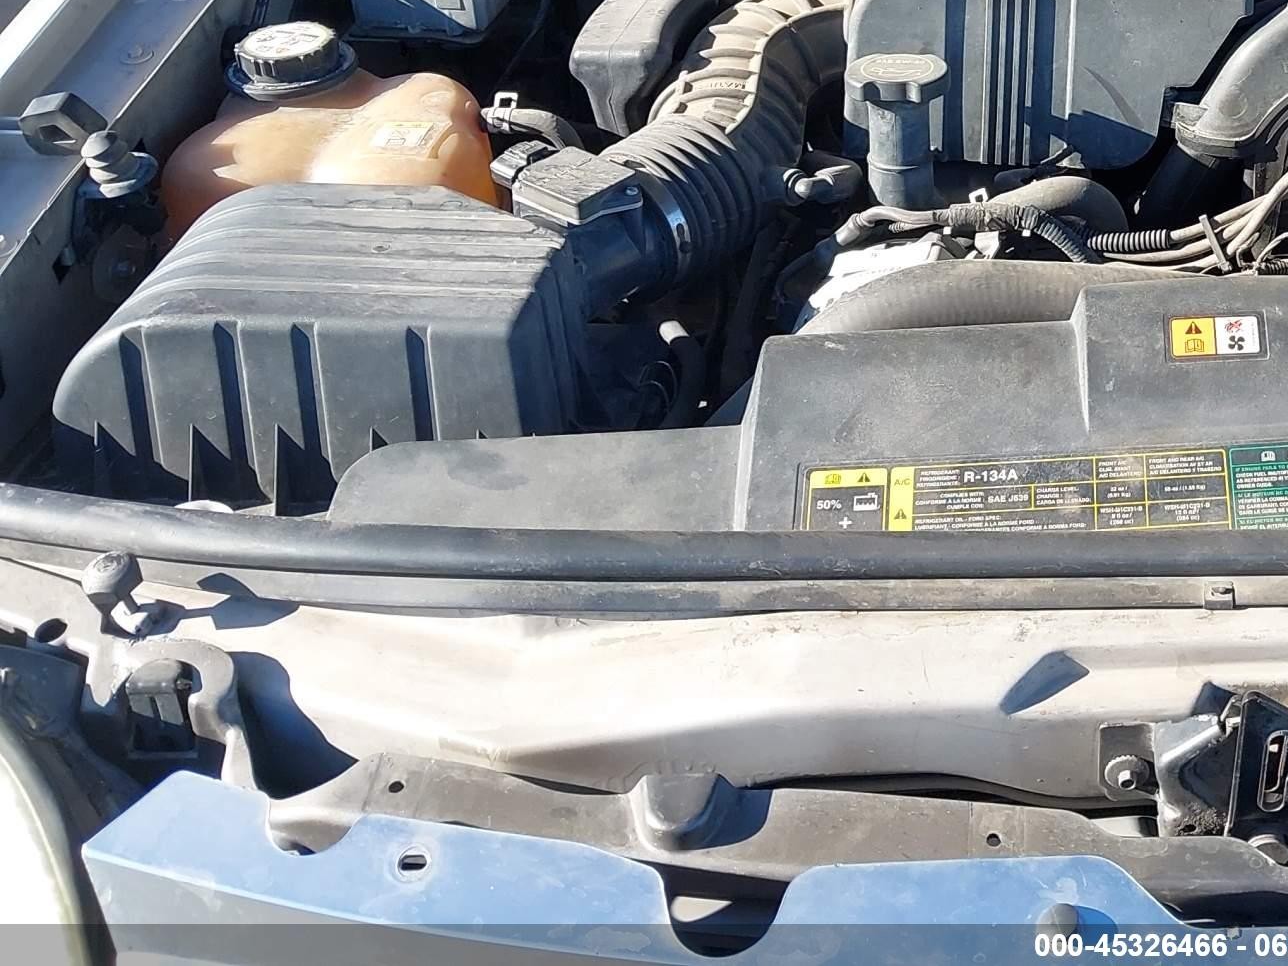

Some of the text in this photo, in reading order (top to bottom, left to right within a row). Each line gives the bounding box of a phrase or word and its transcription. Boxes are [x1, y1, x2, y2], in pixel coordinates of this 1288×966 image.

[964, 468, 1018, 483] R-134A
[894, 478, 911, 486] A/C
[988, 494, 1006, 503] SAE
[816, 500, 842, 510] 50%
